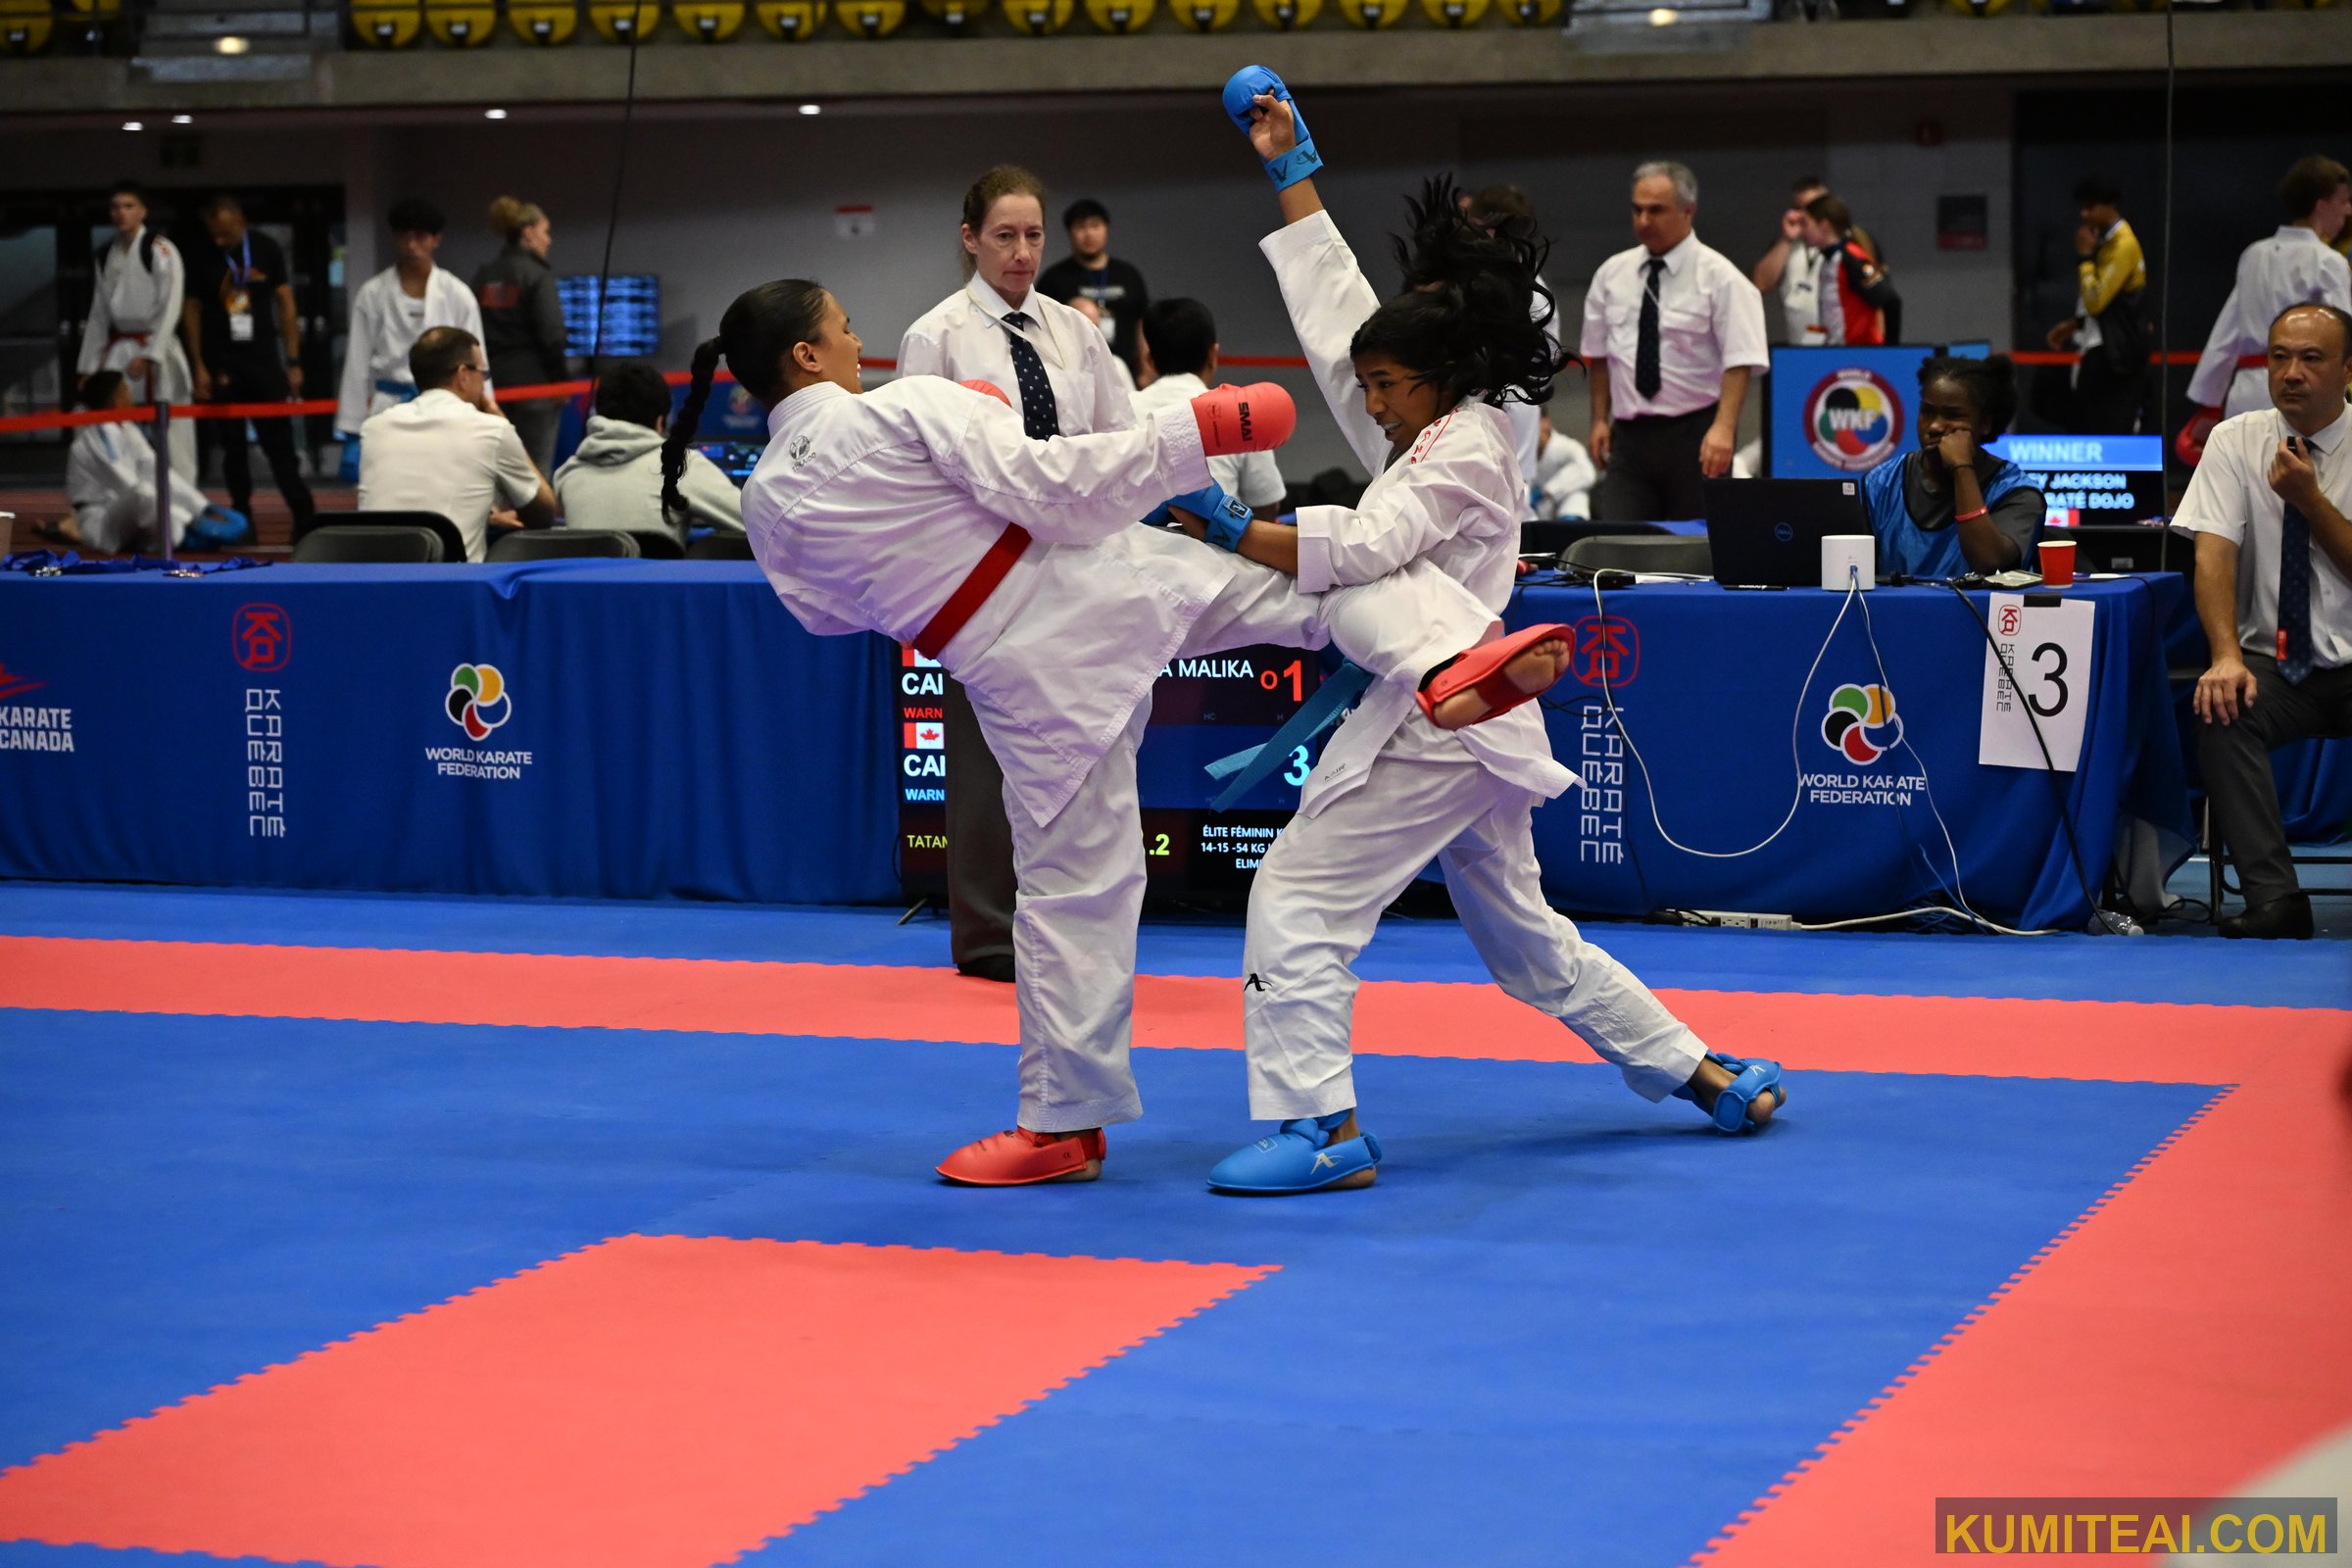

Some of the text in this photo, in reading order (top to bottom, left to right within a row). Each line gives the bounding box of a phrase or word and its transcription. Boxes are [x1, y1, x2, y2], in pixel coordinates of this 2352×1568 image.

[1238, 402, 1253, 441] SMAI
[1829, 408, 1878, 431] WKF
[2009, 441, 2103, 464] WINNER
[2049, 472, 2127, 490] JACKSON
[2088, 492, 2134, 510] DOJO
[1178, 659, 1254, 678] MALIKA
[2028, 642, 2069, 717] 3
[0, 706, 73, 730] KARATE
[0, 728, 75, 753] CANADA
[245, 689, 266, 836] QUÉBEC
[266, 689, 286, 838] KARATÉ
[425, 747, 533, 765] WORLD KARATE
[1284, 744, 1311, 786] 3
[437, 761, 521, 780] FEDERATION
[1799, 773, 1859, 789] WORLD
[1809, 789, 1912, 807] FEDERATION
[1202, 824, 1229, 838] ÉLITE
[1230, 825, 1274, 839] FÉMININ
[1200, 842, 1229, 854] 14-15
[1231, 843, 1249, 855] -54
[1250, 843, 1266, 855] KG
